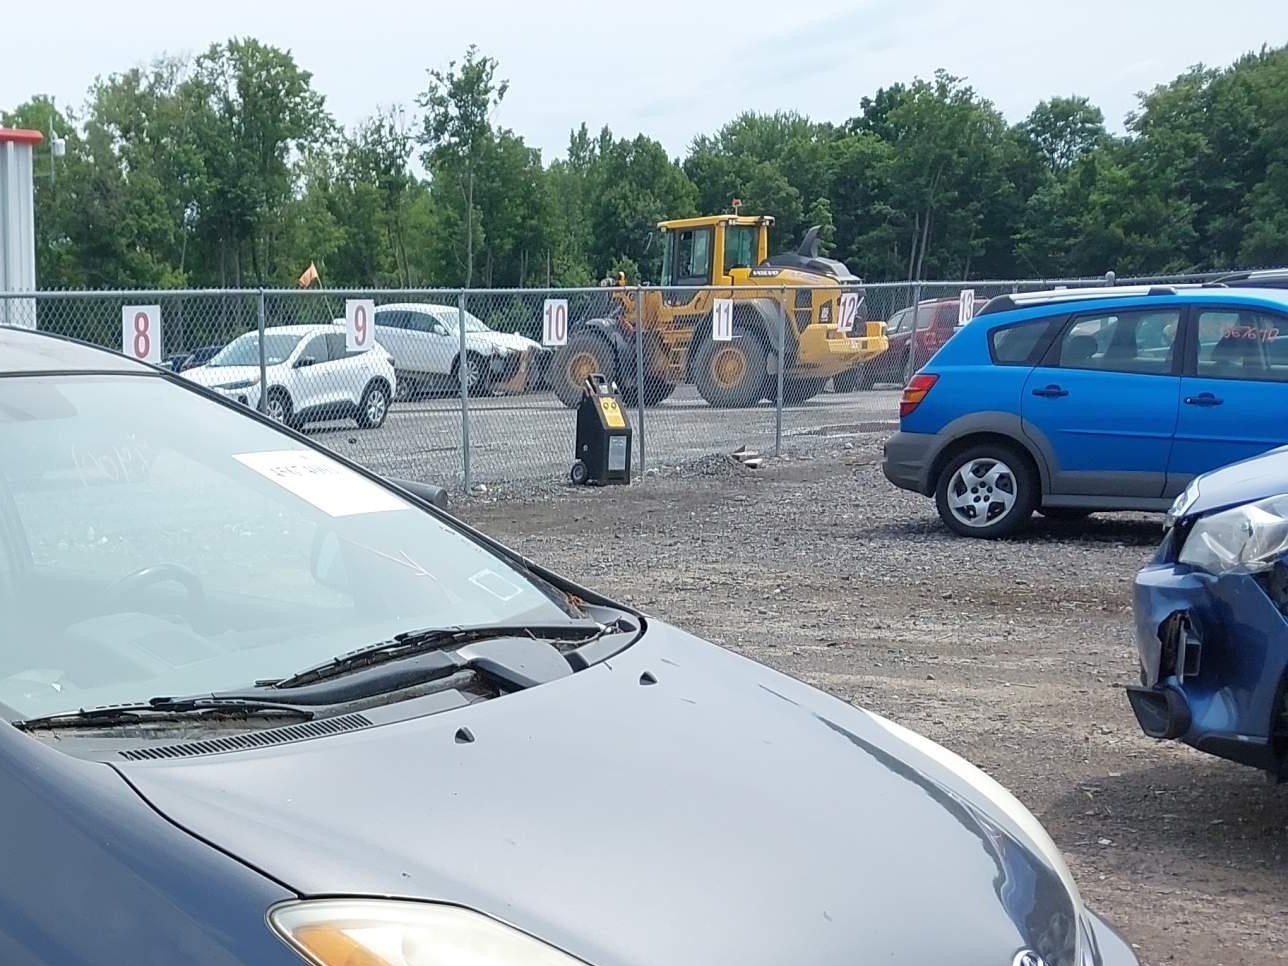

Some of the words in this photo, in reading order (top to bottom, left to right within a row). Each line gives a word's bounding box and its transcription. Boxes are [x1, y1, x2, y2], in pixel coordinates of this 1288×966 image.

[544, 303, 566, 342] 10
[715, 302, 730, 337] 11
[839, 295, 856, 328] 12
[960, 291, 974, 322] 13
[134, 312, 150, 359] 8
[354, 305, 367, 346] 9
